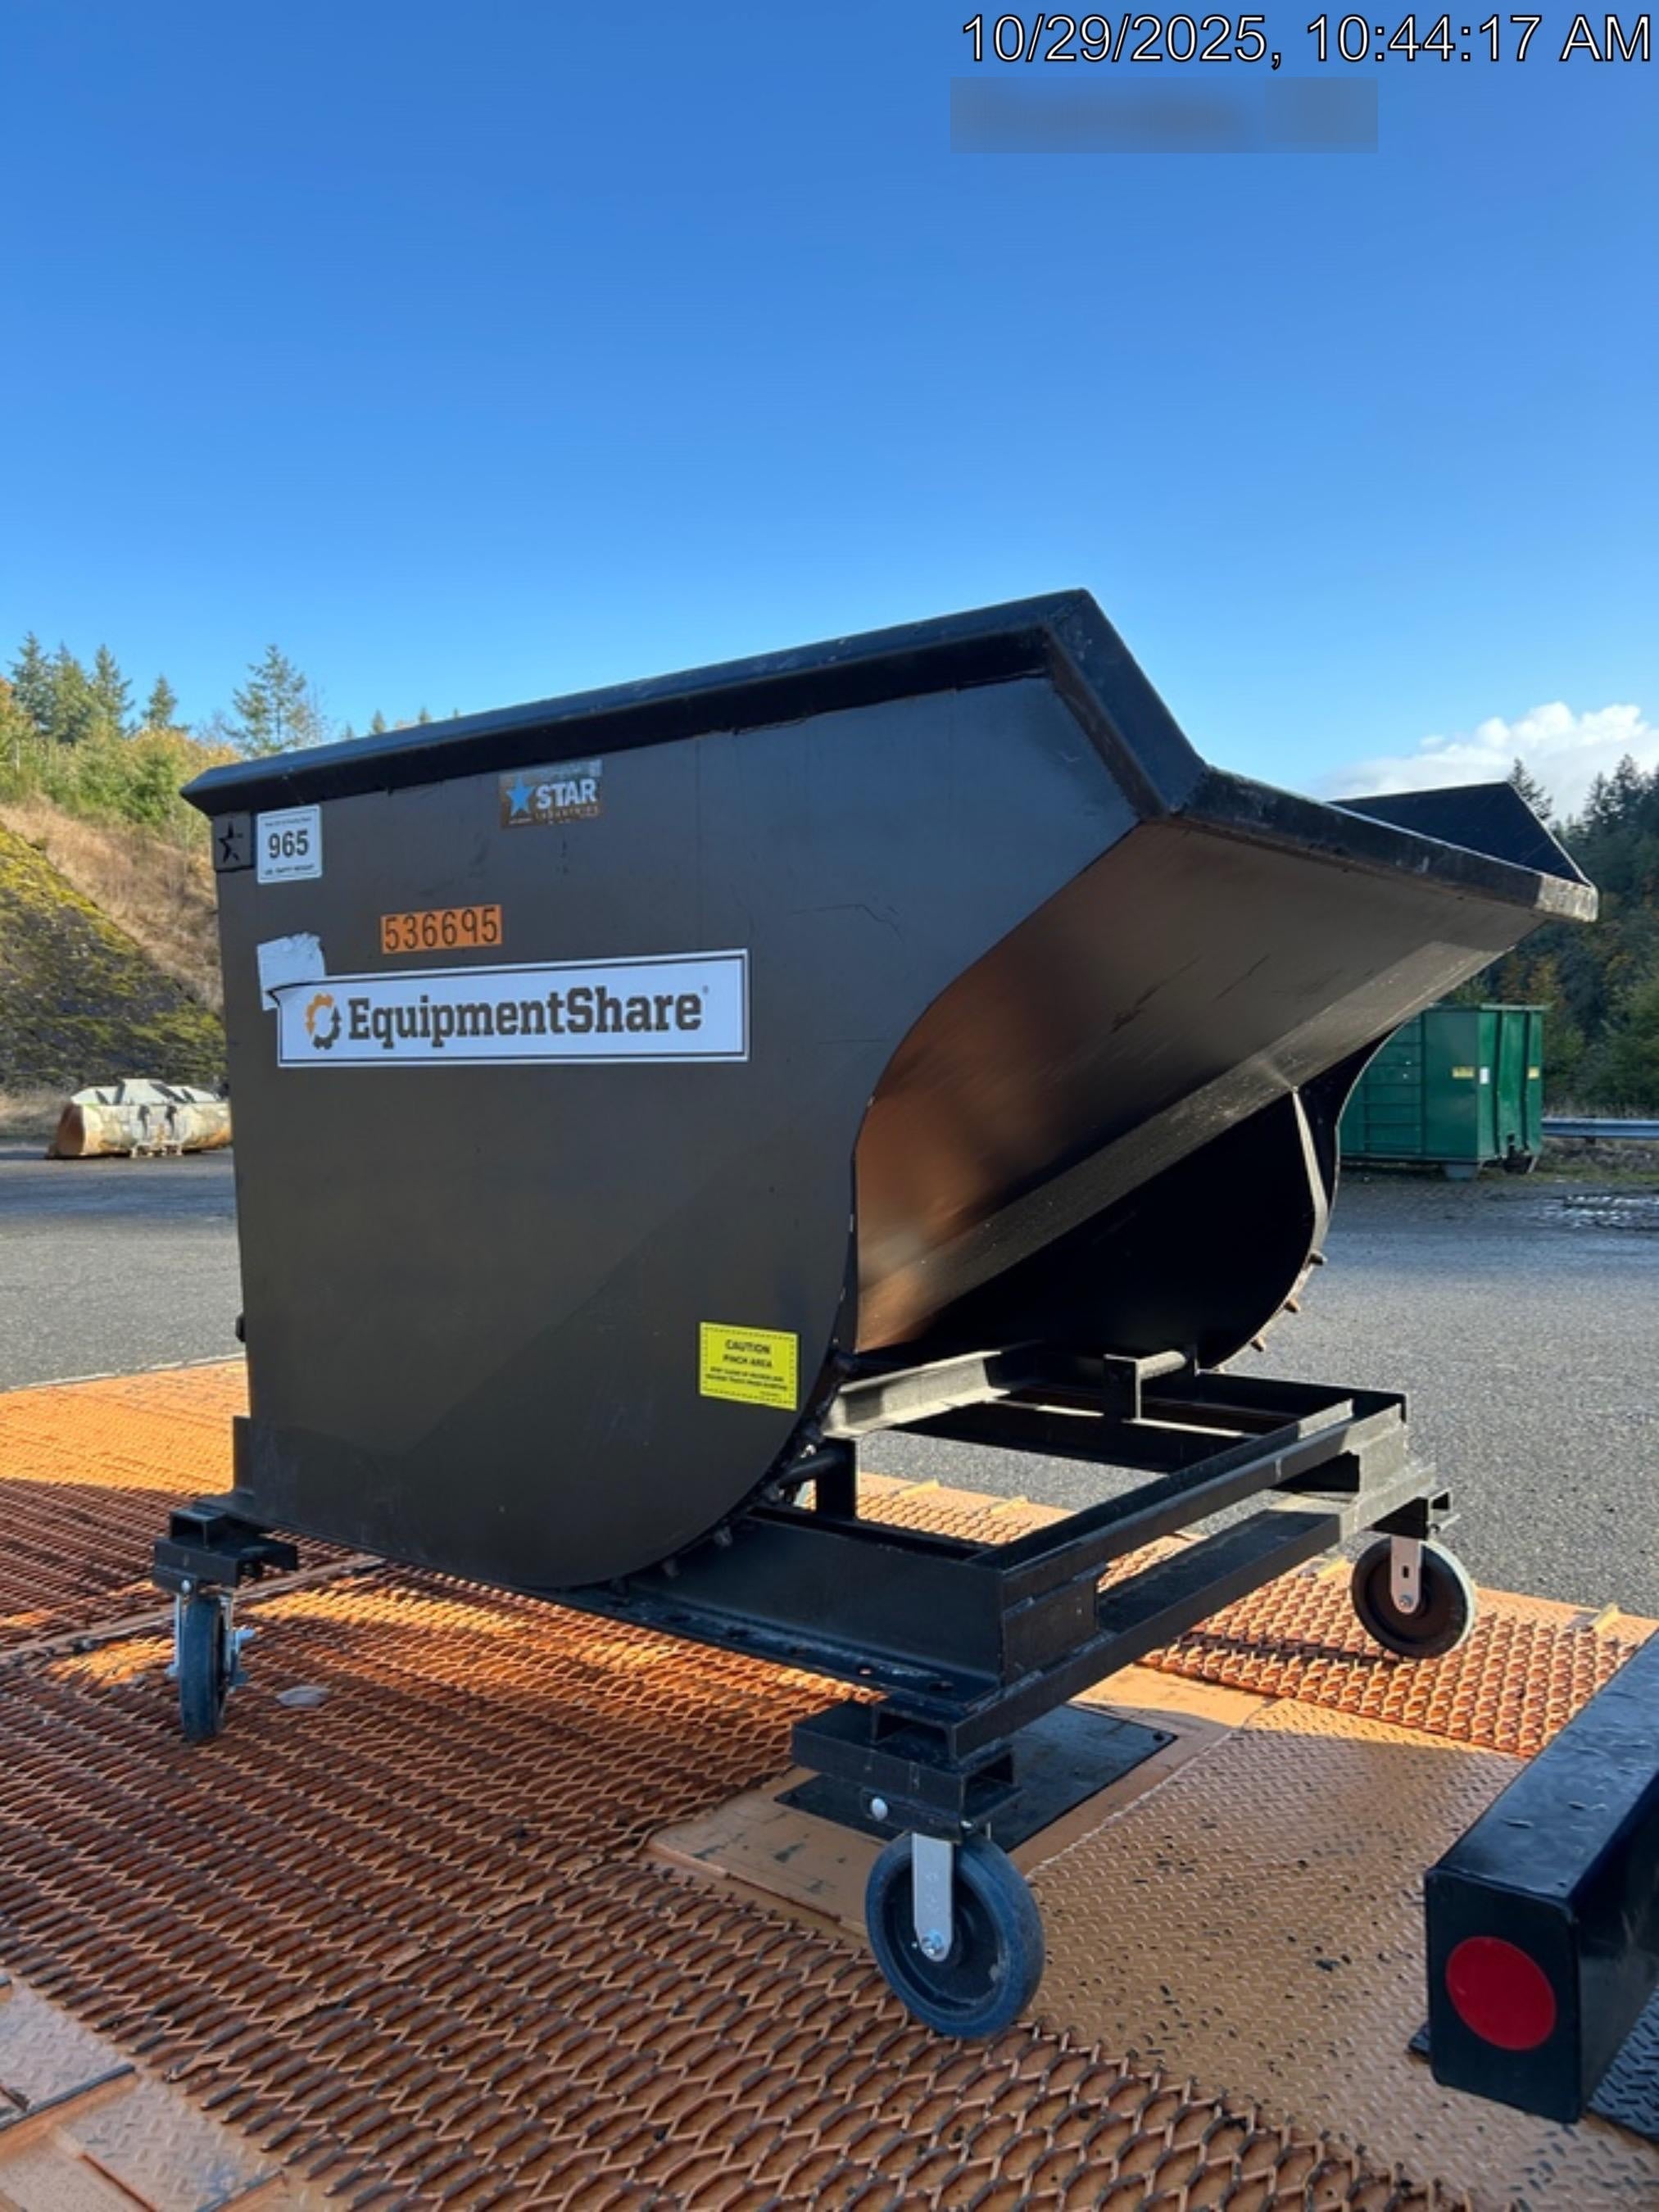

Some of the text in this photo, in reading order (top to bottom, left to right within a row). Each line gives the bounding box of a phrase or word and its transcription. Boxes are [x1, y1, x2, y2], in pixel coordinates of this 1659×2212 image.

[535, 777, 597, 810] STAR
[268, 828, 309, 860] 965
[384, 907, 497, 950] 536695
[348, 986, 702, 1049] EquipmentShare
[725, 1339, 771, 1354] CAUTION
[751, 1358, 773, 1368] AREA
